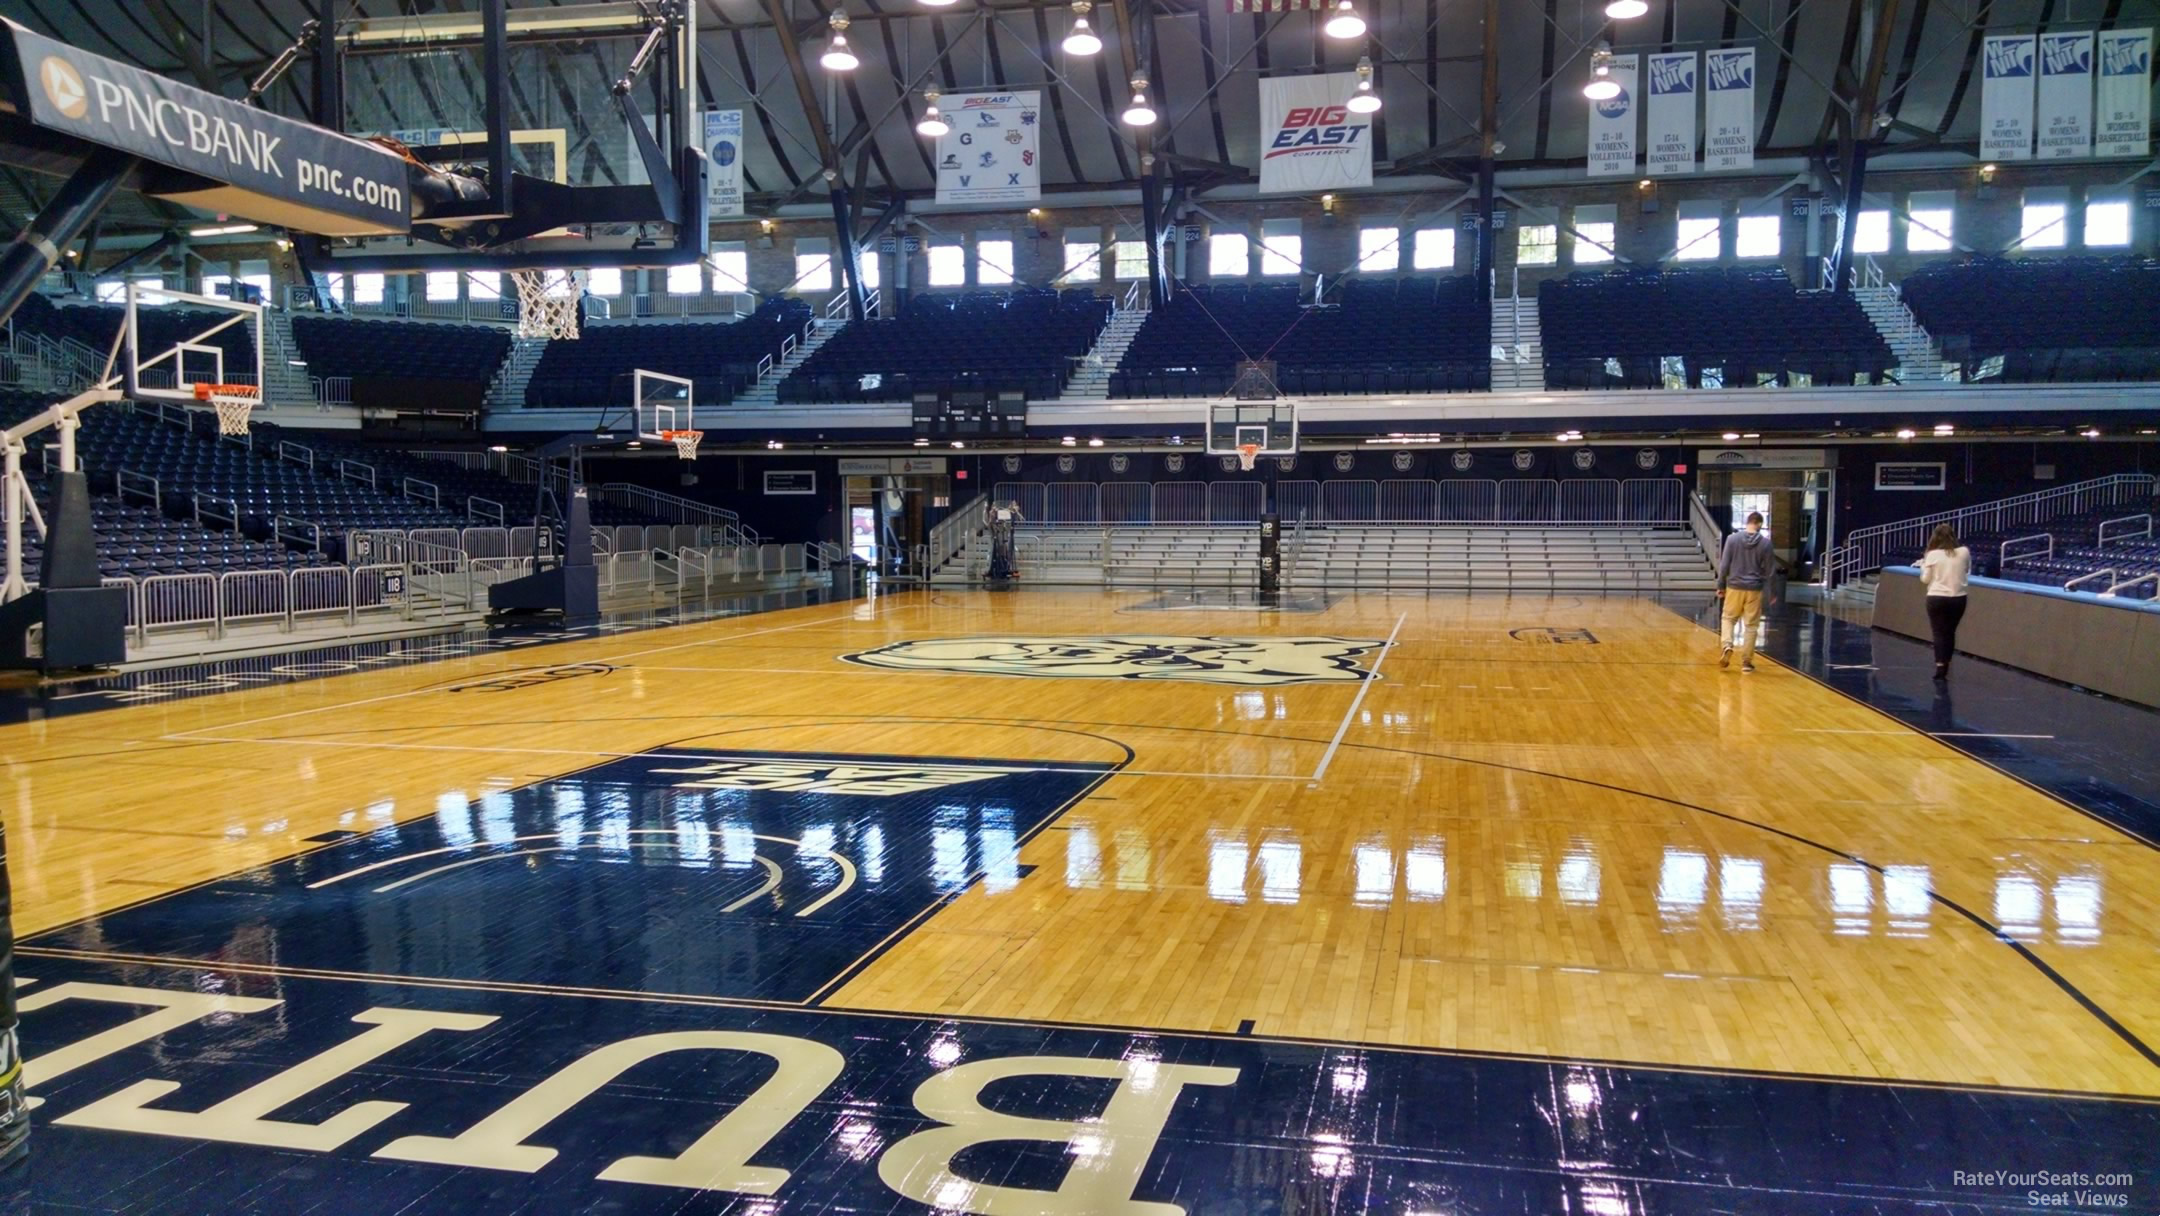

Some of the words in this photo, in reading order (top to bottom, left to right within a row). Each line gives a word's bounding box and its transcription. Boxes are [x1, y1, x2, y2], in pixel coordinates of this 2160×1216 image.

[1281, 105, 1347, 129] BIG
[960, 132, 972, 145] G
[1271, 124, 1369, 148] EAST
[2041, 136, 2087, 147] BASKETBALL
[2098, 132, 2147, 143] BASKETBALL
[1984, 139, 2027, 149] BASKETBALL
[1292, 149, 1350, 158] CONFERENCE
[1590, 151, 1633, 161] VOLLEYBALL
[1707, 145, 1752, 157] BASKETBALL
[1650, 153, 1692, 163] BASKETBALL
[297, 158, 401, 212] pnc.com
[959, 175, 971, 187] V
[1008, 173, 1020, 185] X
[1793, 206, 1808, 216] 201
[1185, 231, 1200, 241] 224
[388, 577, 401, 592] 118
[14, 978, 1240, 1216] BUTL
